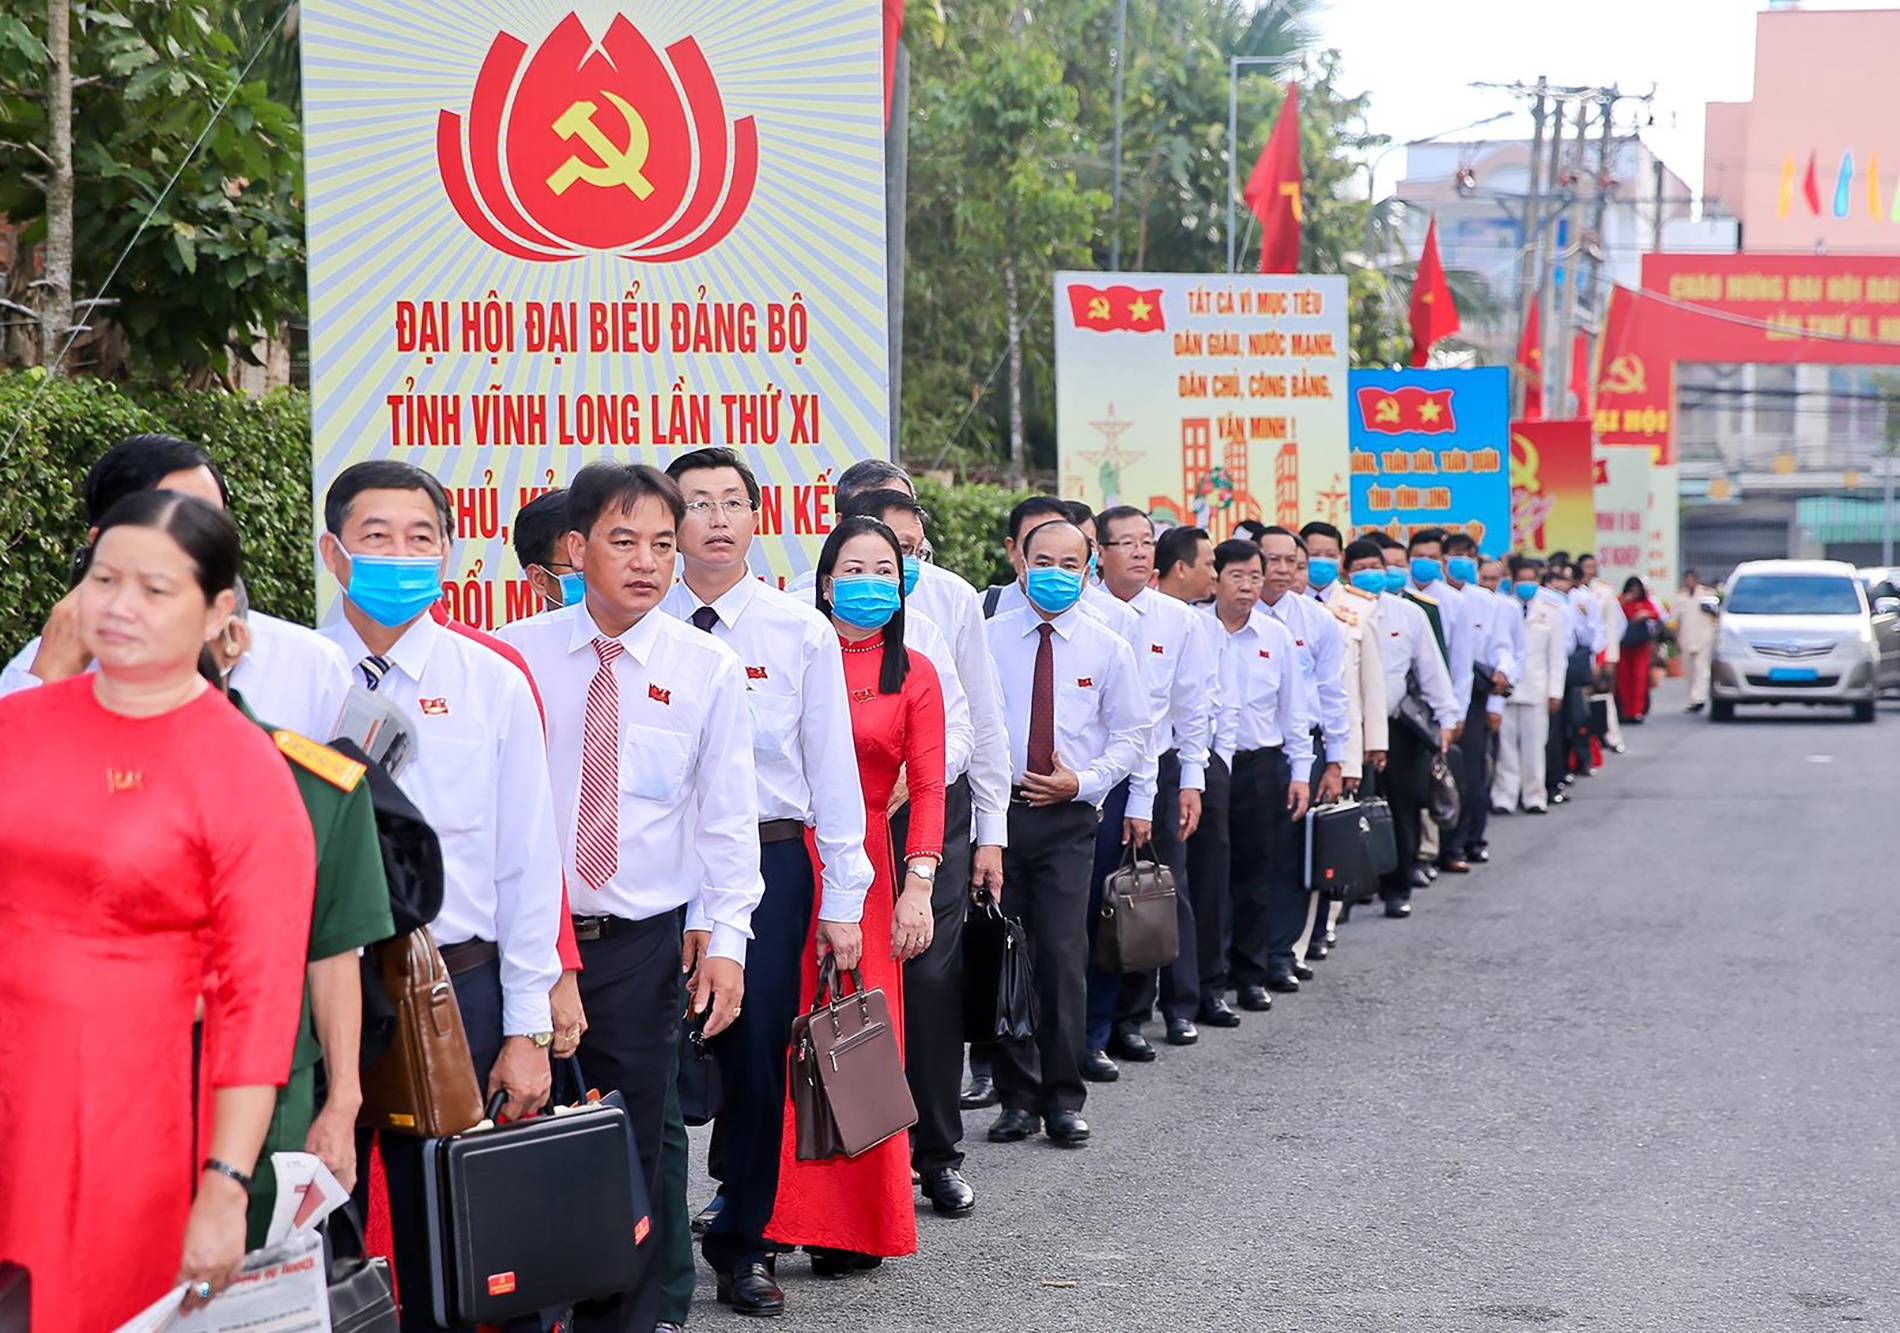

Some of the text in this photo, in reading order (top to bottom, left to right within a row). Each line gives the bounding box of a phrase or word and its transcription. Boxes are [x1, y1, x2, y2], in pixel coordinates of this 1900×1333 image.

[396, 280, 807, 365] ĐẠI HỘI ĐẠI BIỂU ĐẢNG BỘ
[387, 376, 819, 446] TỈNH VĨNH LONG LẦN THỨ XI
[794, 468, 838, 535] KẾ
[442, 559, 494, 632] ĐỔI
